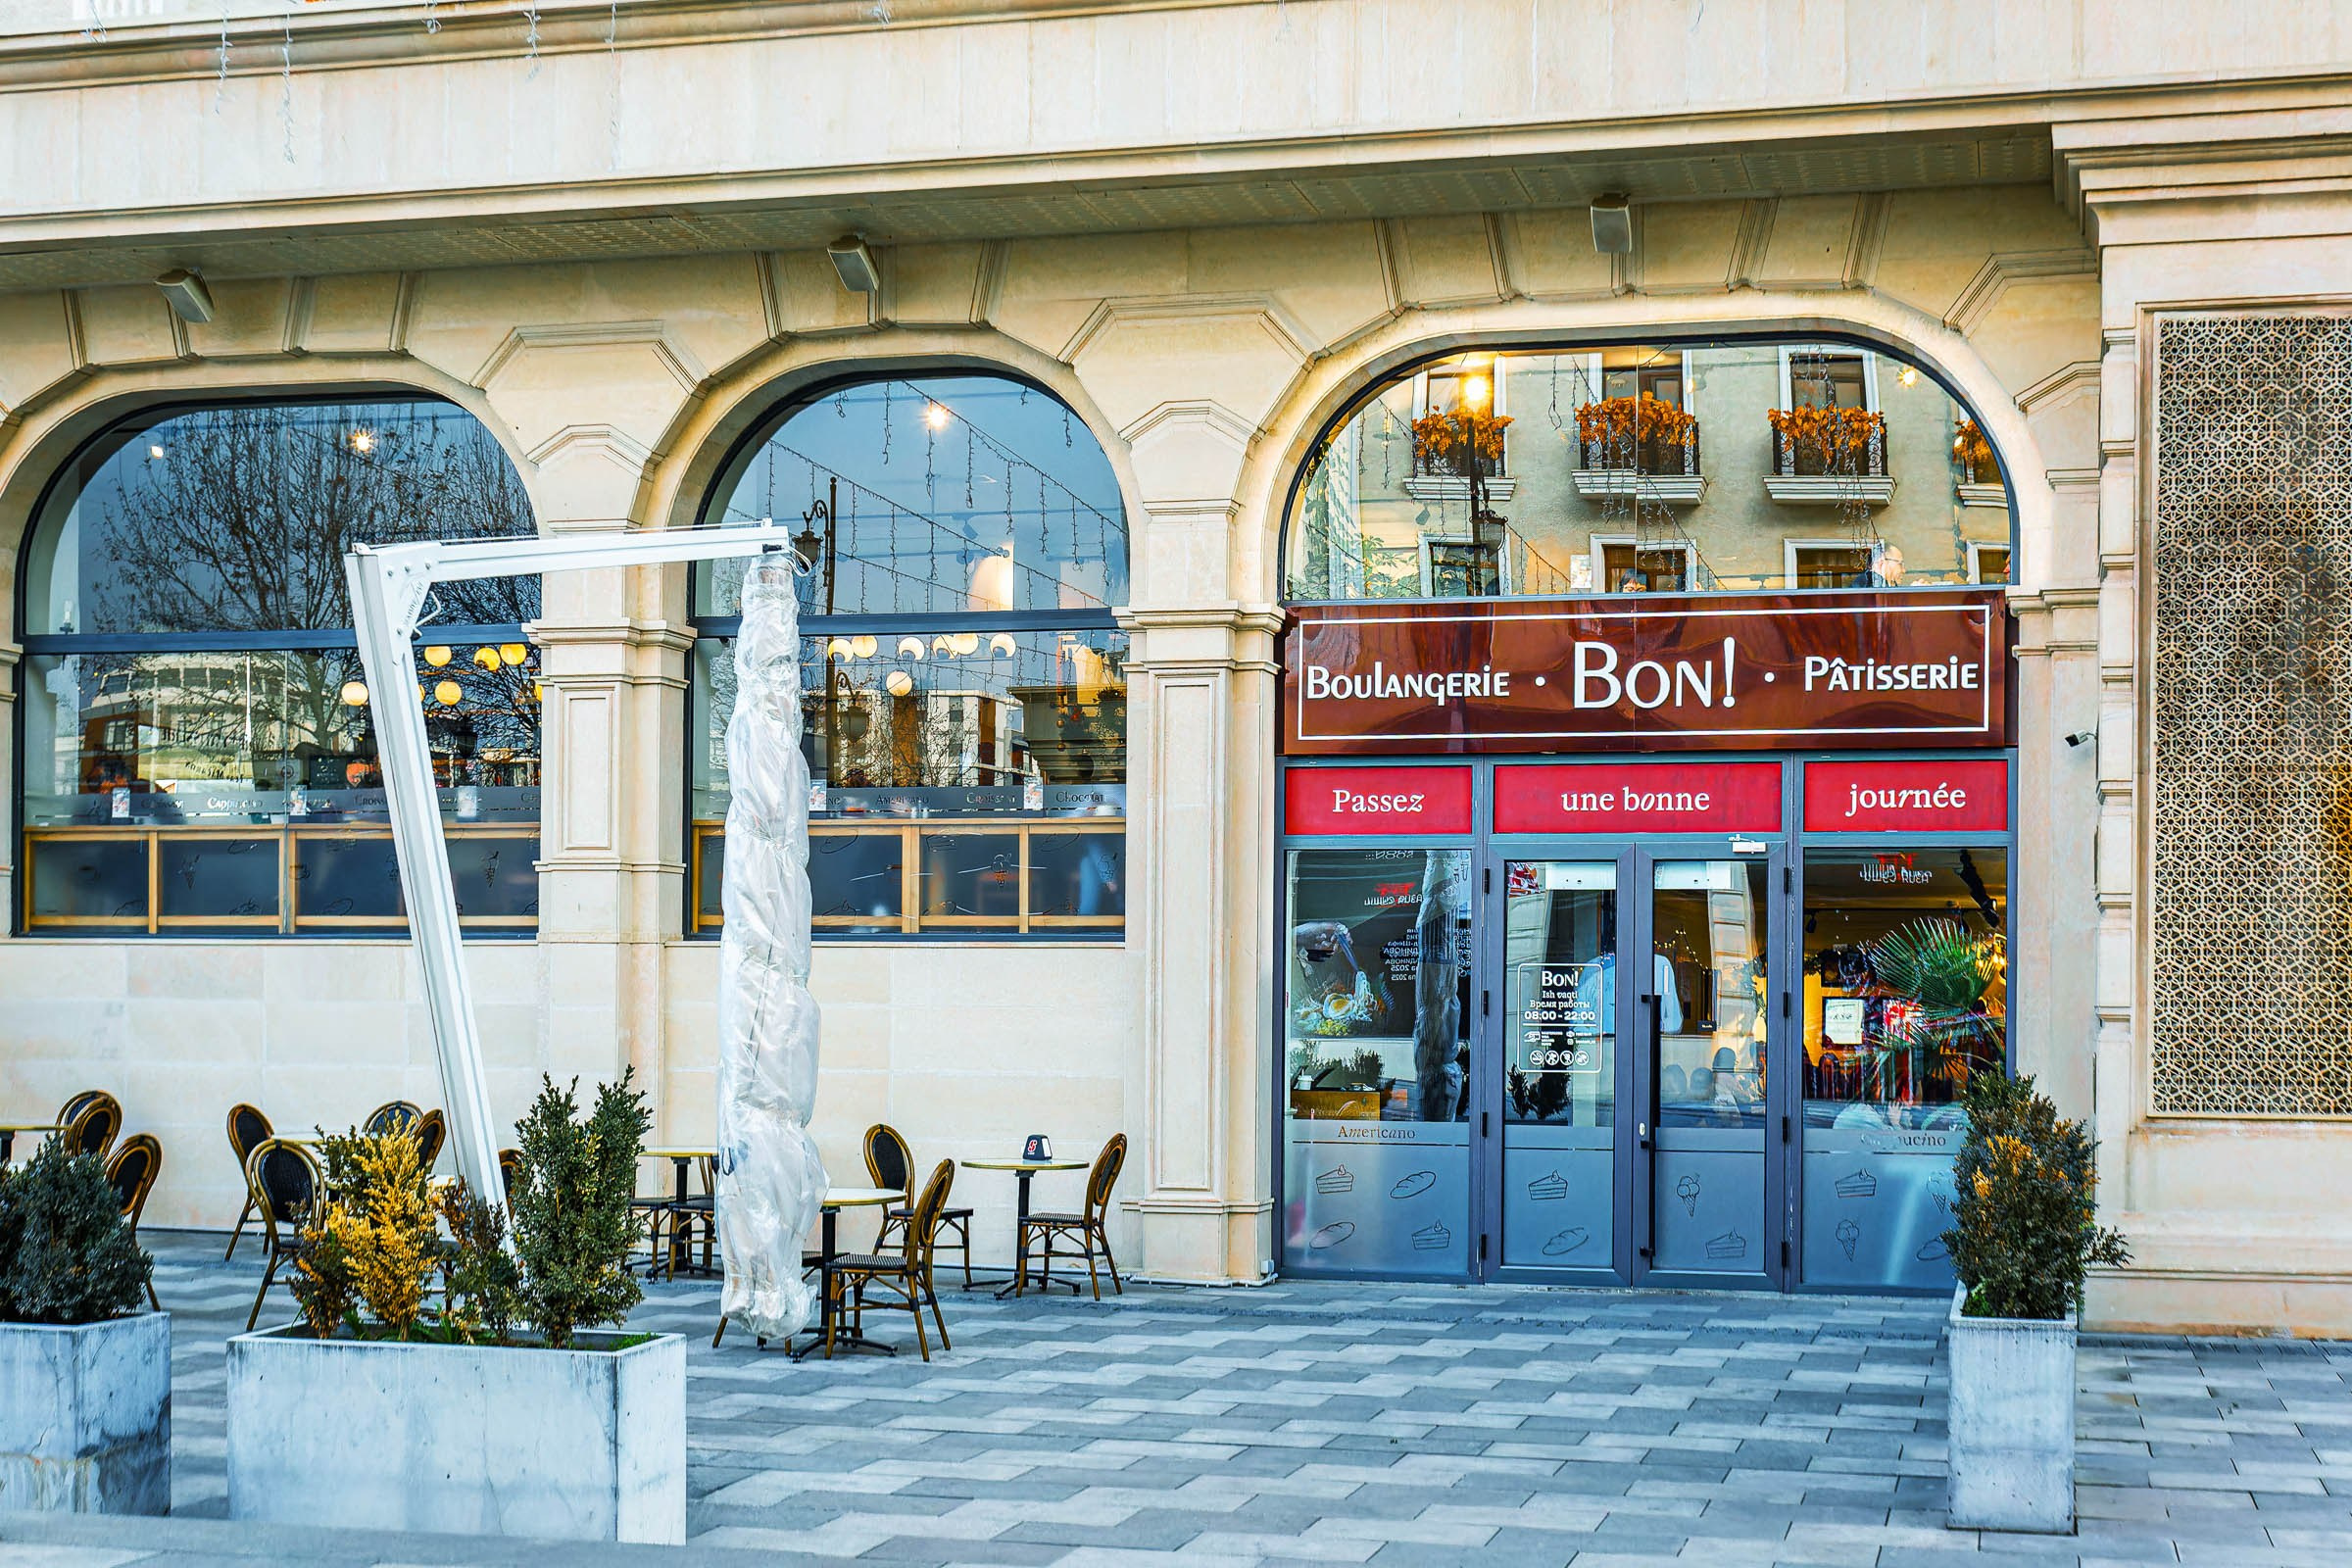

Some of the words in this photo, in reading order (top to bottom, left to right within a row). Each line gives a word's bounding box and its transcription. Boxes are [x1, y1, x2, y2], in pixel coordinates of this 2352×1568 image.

[1332, 789, 1425, 812] Passez
[1560, 793, 1615, 812] une
[1622, 786, 1711, 812] bonne
[1844, 782, 1966, 817] journée
[1542, 990, 1555, 999] Ish
[1530, 1000, 1557, 1009] Время
[1558, 1000, 1591, 1010] работы
[1524, 1010, 1556, 1020] 08:00
[1564, 1010, 1595, 1020] 22:00
[1337, 1125, 1416, 1139] Americano
